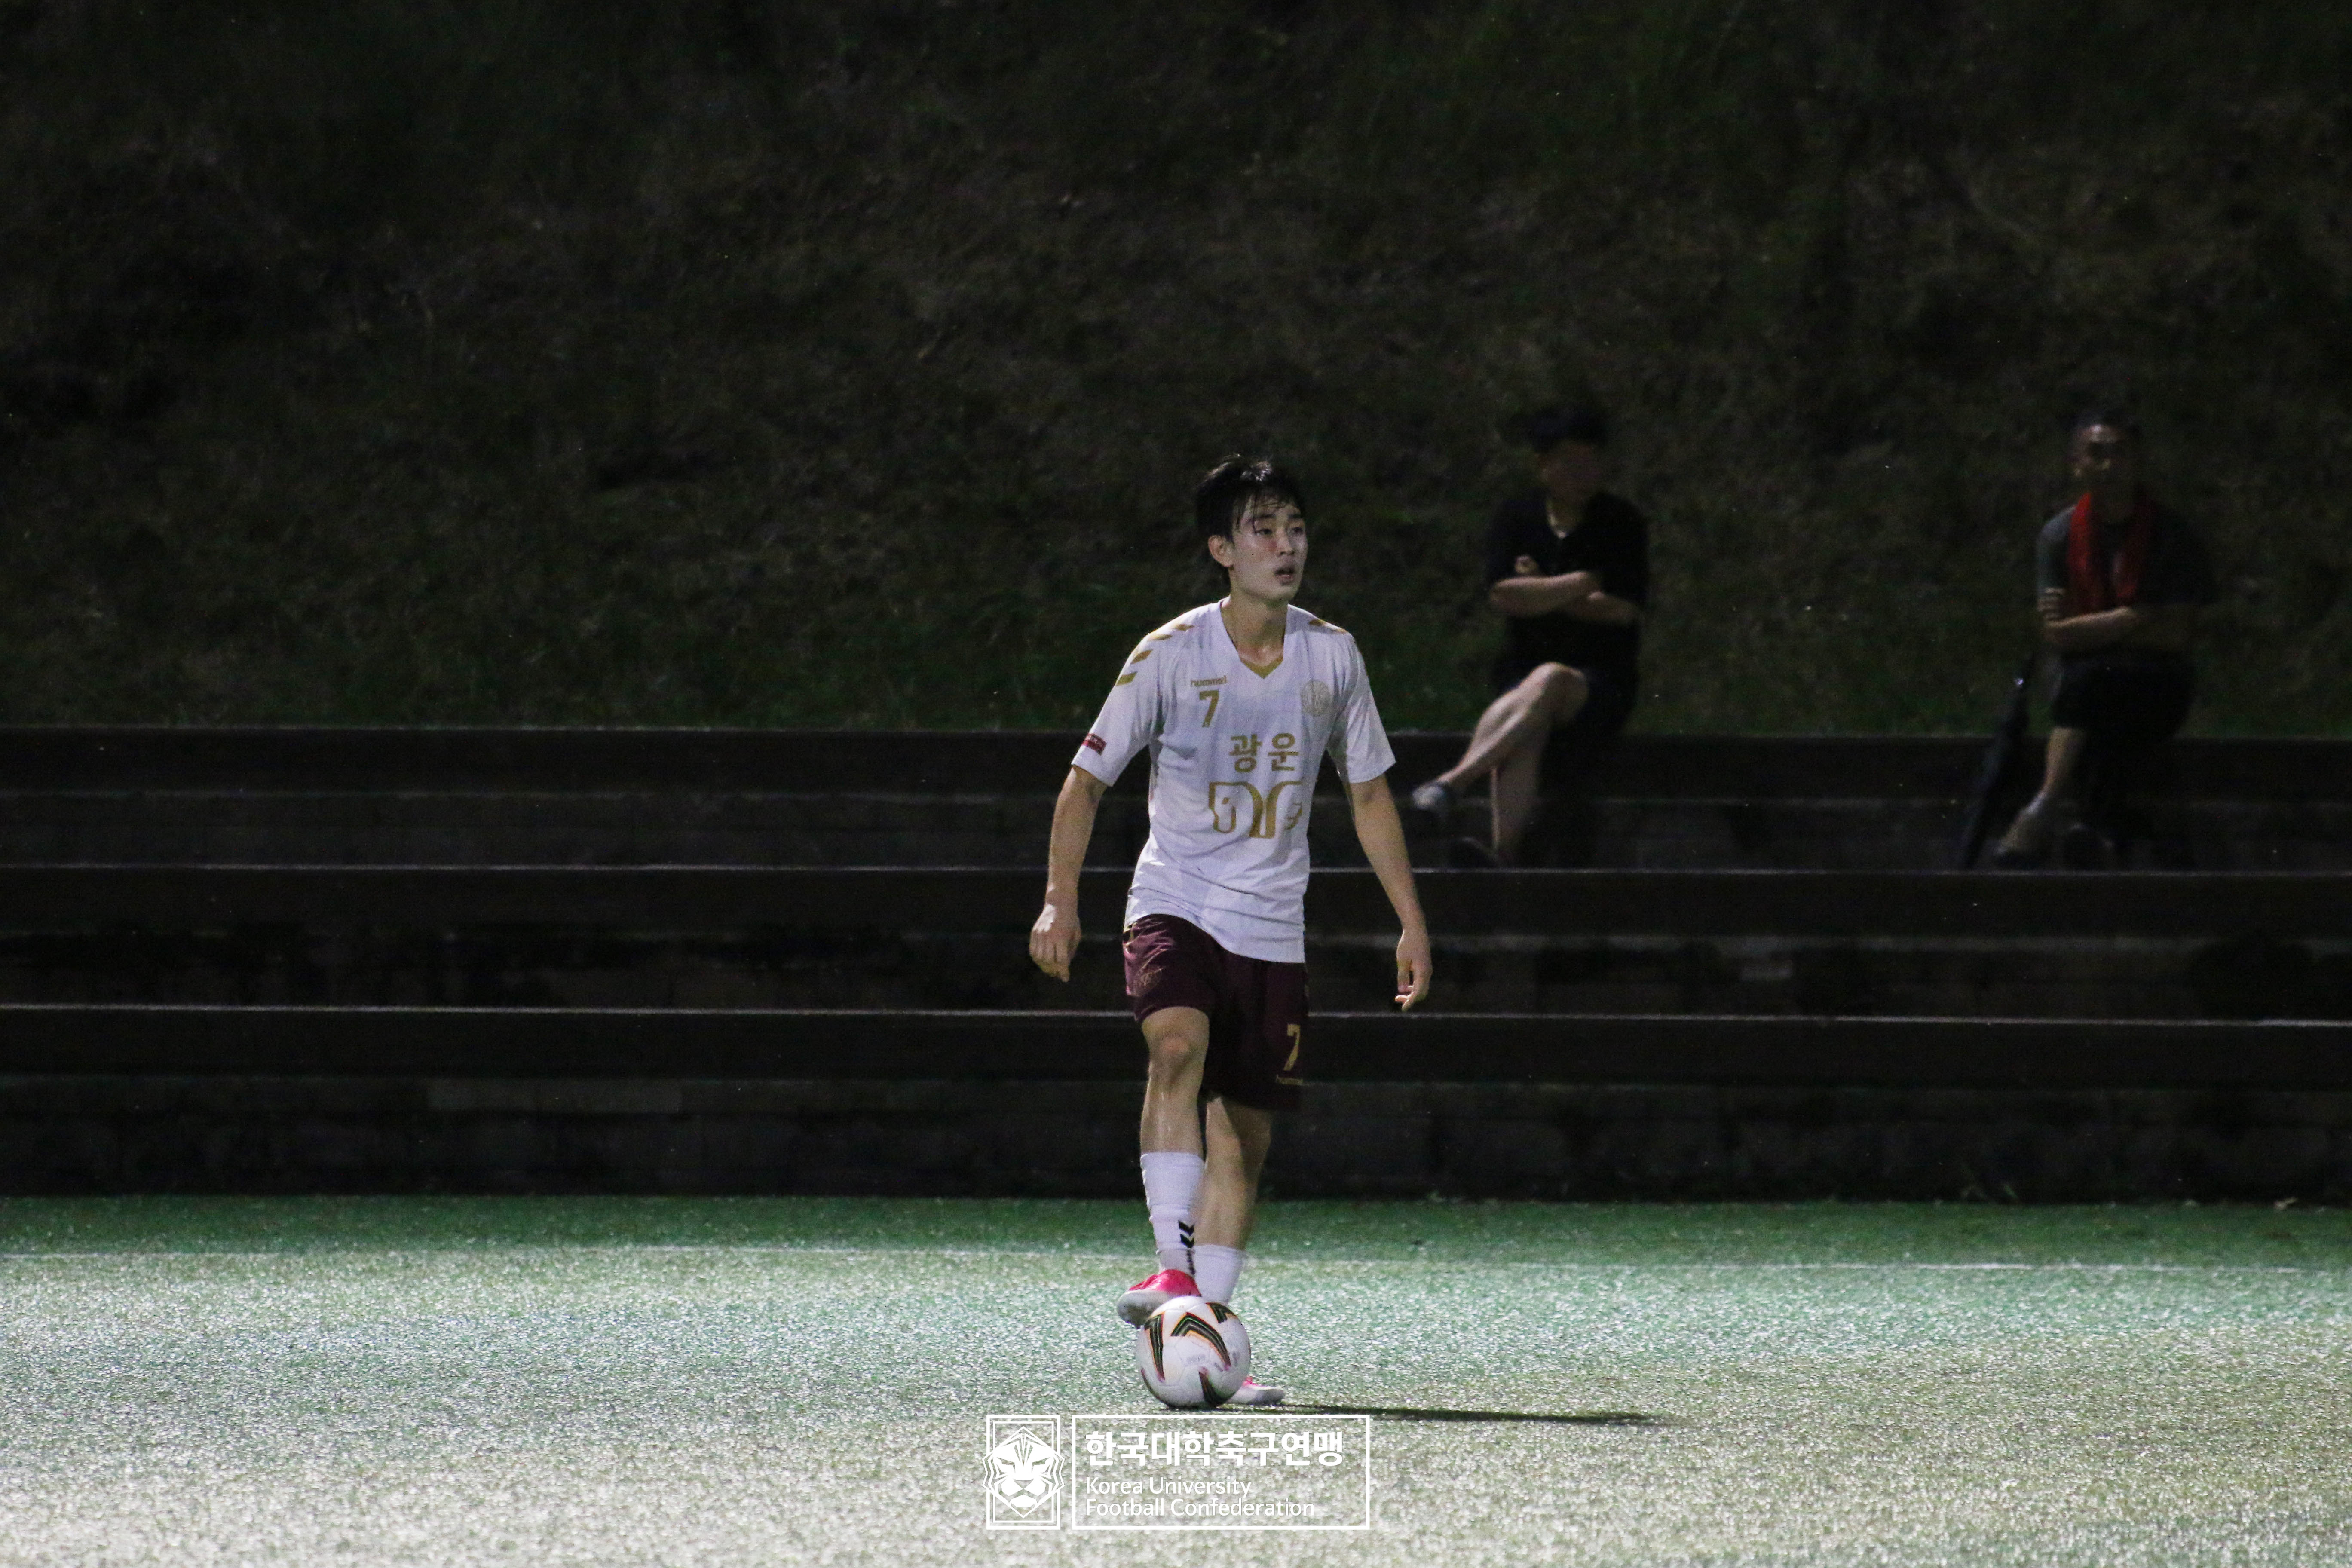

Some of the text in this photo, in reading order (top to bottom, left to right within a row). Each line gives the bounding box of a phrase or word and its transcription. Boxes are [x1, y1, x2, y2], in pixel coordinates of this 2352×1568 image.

[1199, 689, 1219, 728] 7
[1228, 733, 1299, 772] 광운
[1283, 1024, 1301, 1071] 7
